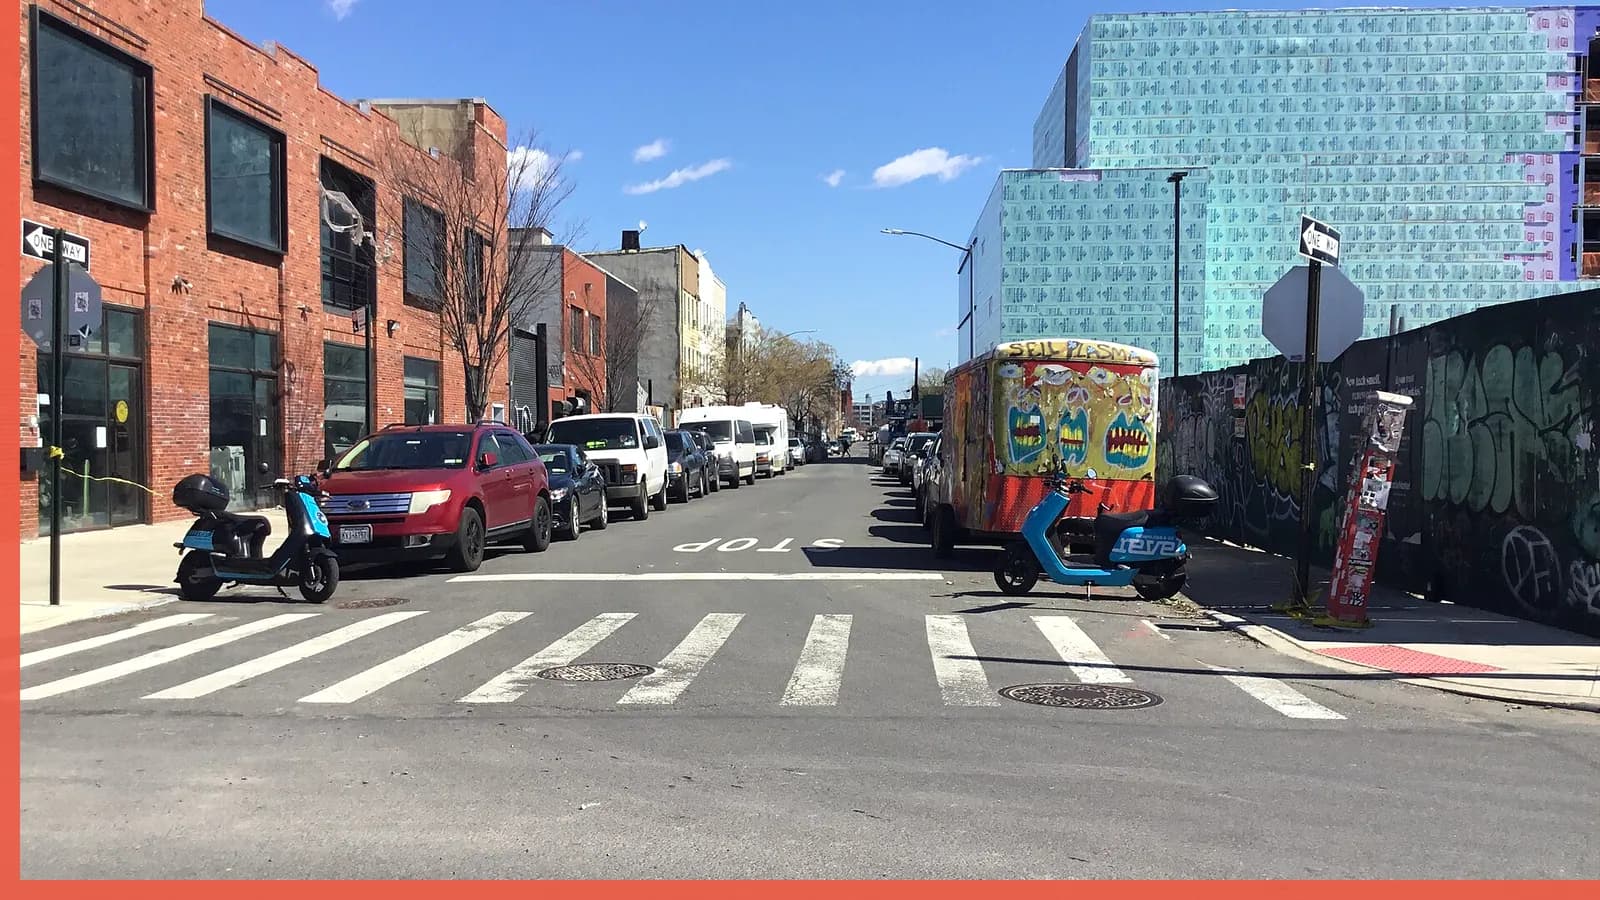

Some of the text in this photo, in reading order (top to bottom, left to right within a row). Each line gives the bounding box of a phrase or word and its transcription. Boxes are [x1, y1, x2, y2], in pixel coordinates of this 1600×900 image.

[33, 234, 81, 259] ONE WAY
[1308, 230, 1338, 255] ONE WAY
[1008, 340, 1143, 362] SELL PLASMA
[672, 537, 845, 552] STOP
